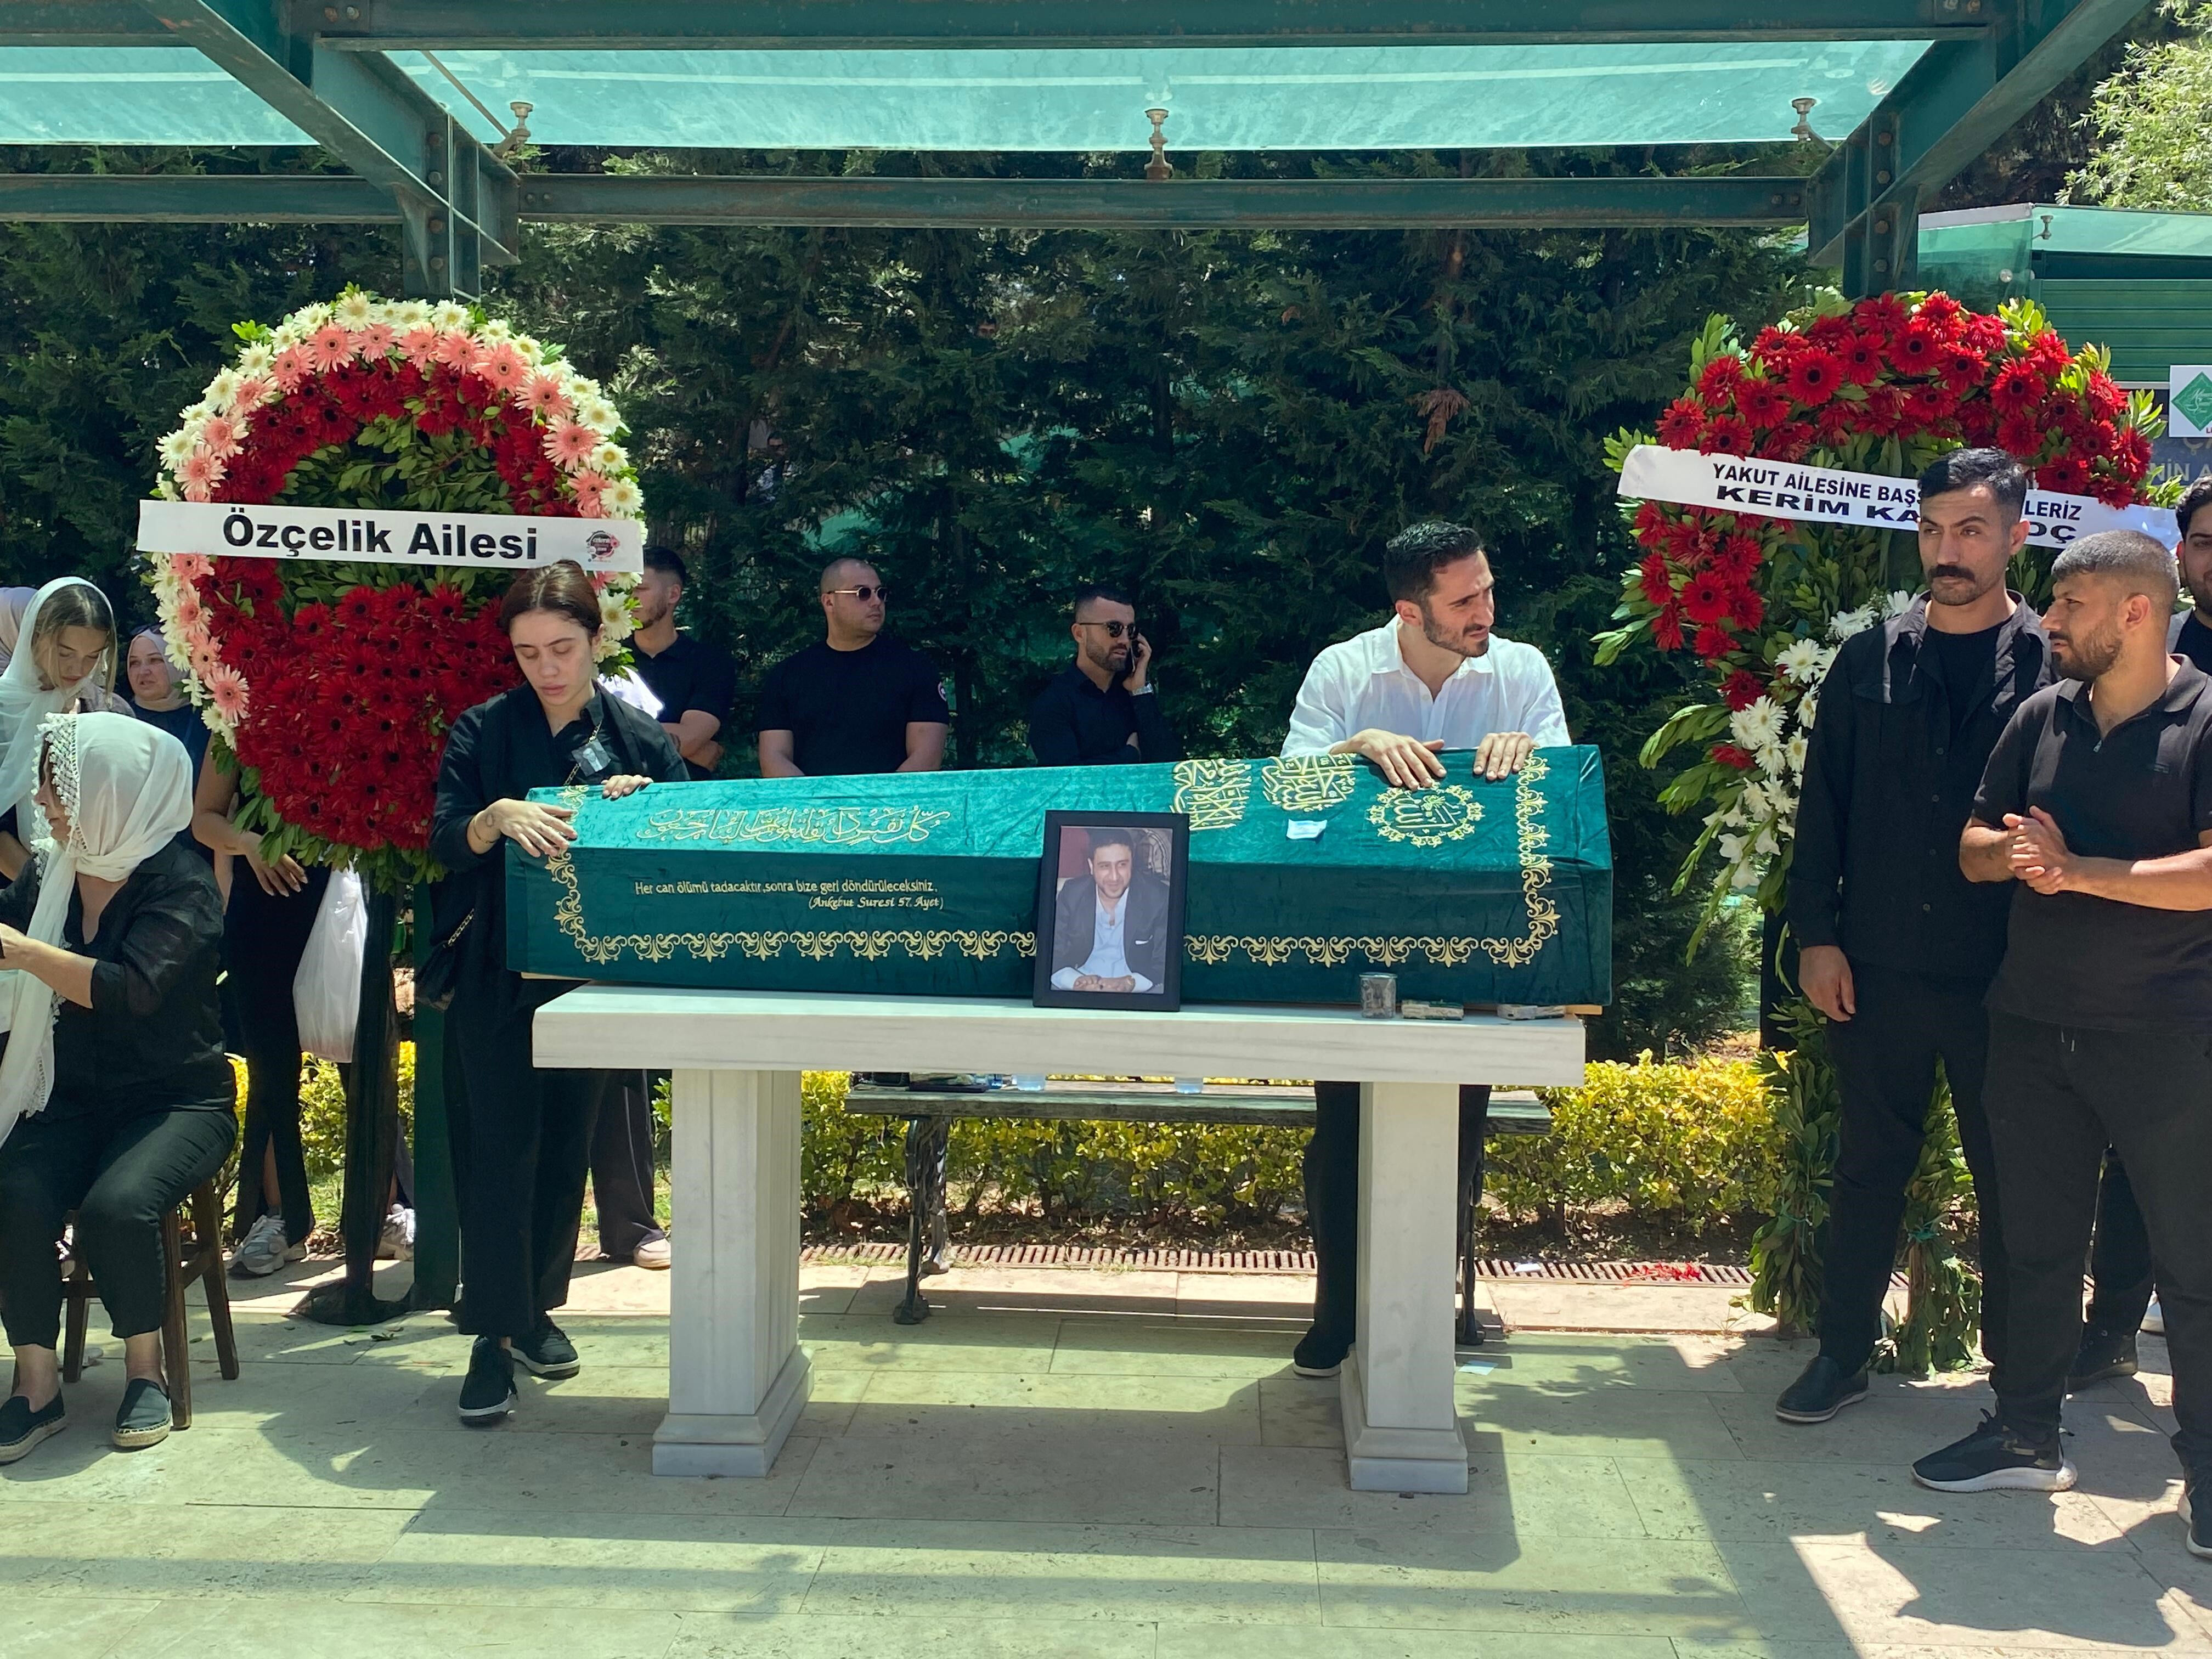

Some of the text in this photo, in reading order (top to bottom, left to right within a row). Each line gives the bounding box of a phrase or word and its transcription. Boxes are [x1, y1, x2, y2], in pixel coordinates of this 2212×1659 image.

[1713, 462, 2083, 521] YAKUT AİLESİNE BAŞ LERİZ
[1717, 485, 2077, 544] KERİM KA OÇ
[222, 506, 538, 560] Özçelik Ailesi
[635, 881, 653, 895] Her
[656, 884, 675, 894] can
[676, 881, 709, 894] ölümü
[795, 879, 817, 892] bize
[820, 879, 839, 894] geri
[857, 896, 895, 909] Suresi
